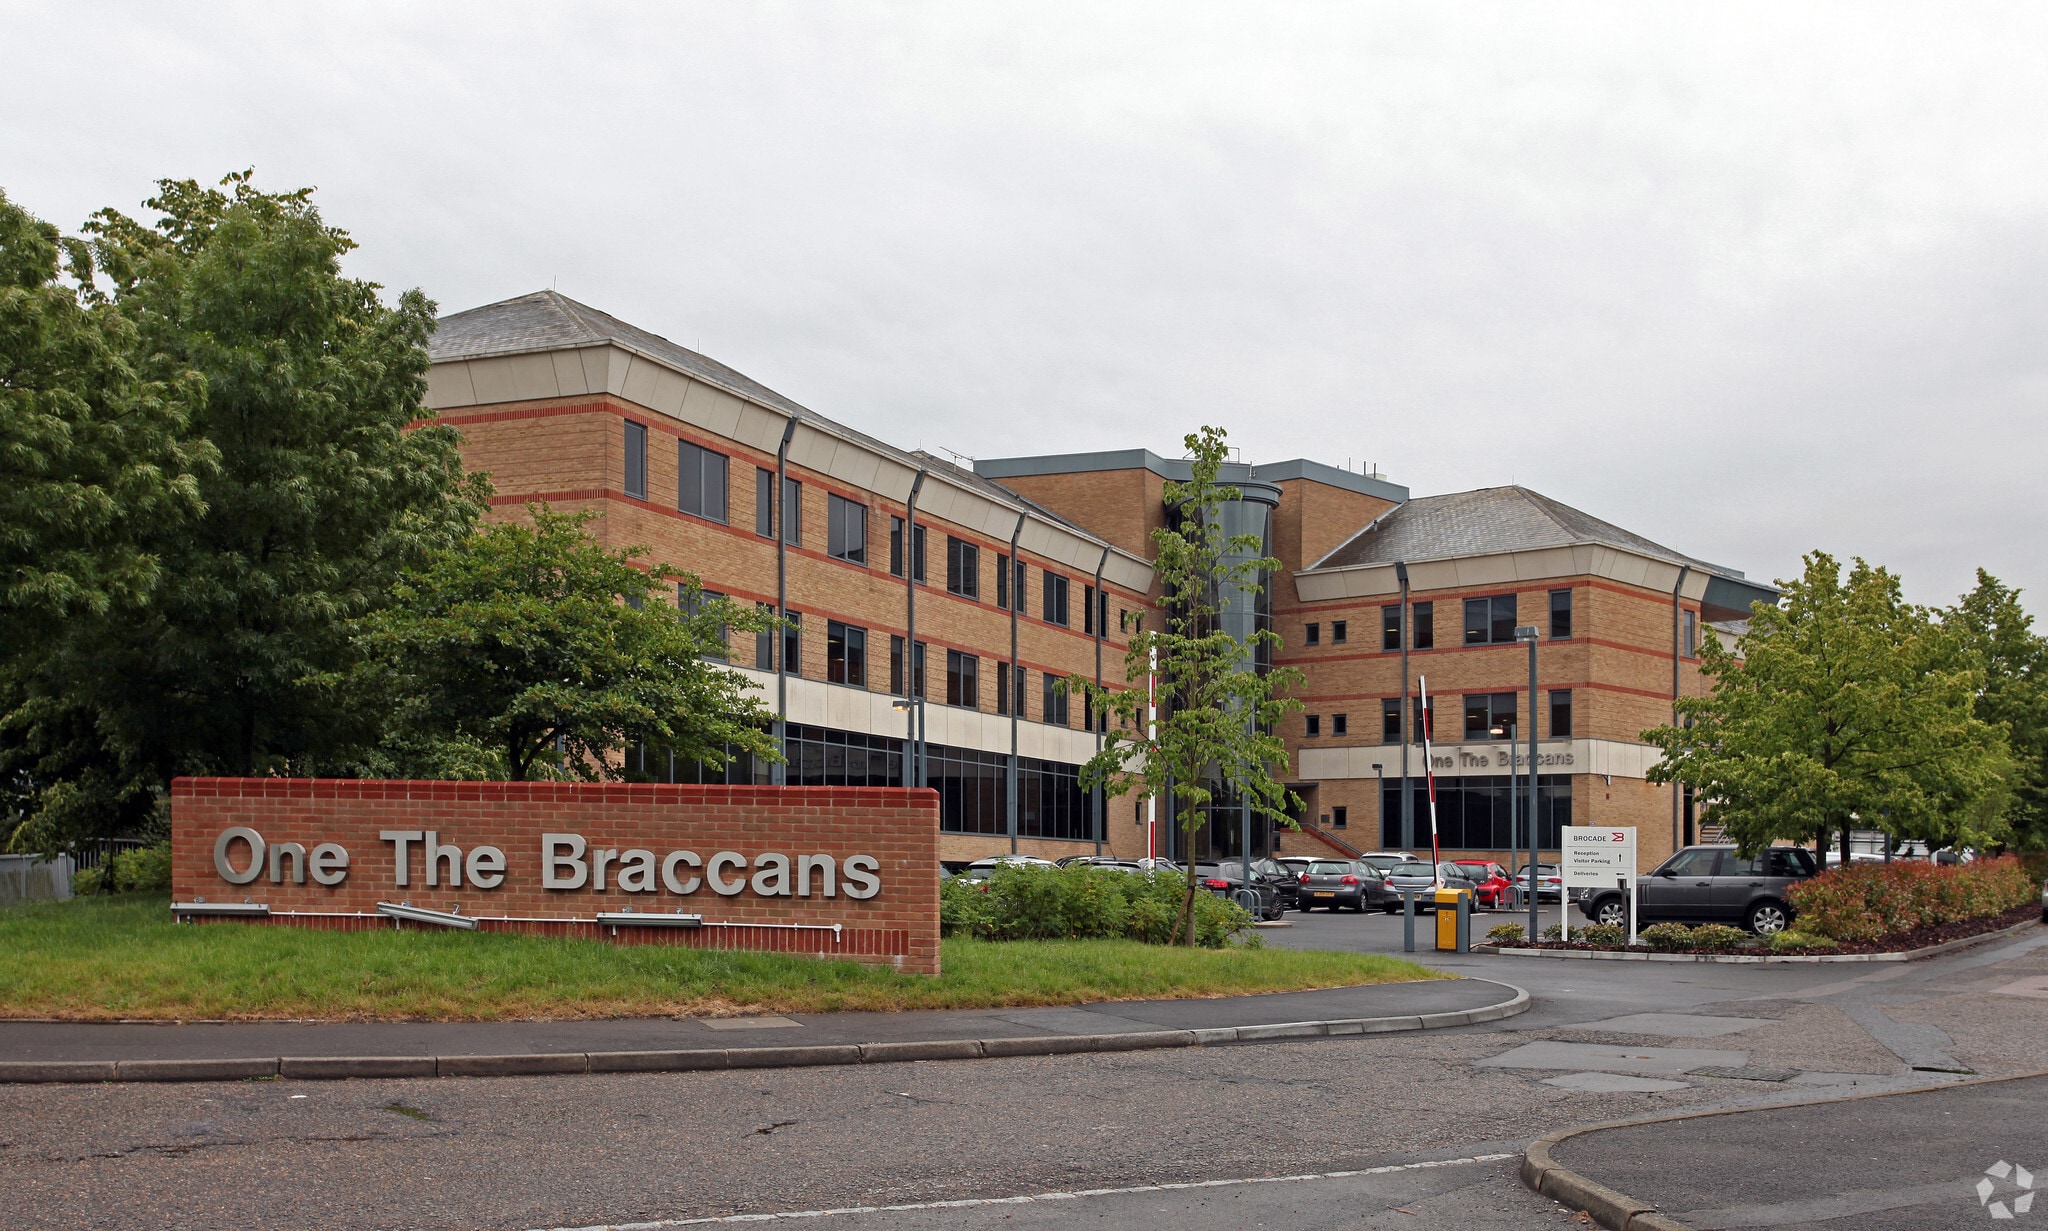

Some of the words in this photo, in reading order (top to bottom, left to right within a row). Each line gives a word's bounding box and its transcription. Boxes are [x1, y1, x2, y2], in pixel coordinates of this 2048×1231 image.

[1460, 752, 1489, 767] The
[213, 826, 350, 886] One
[379, 830, 507, 889] The
[541, 833, 882, 900] Braccans
